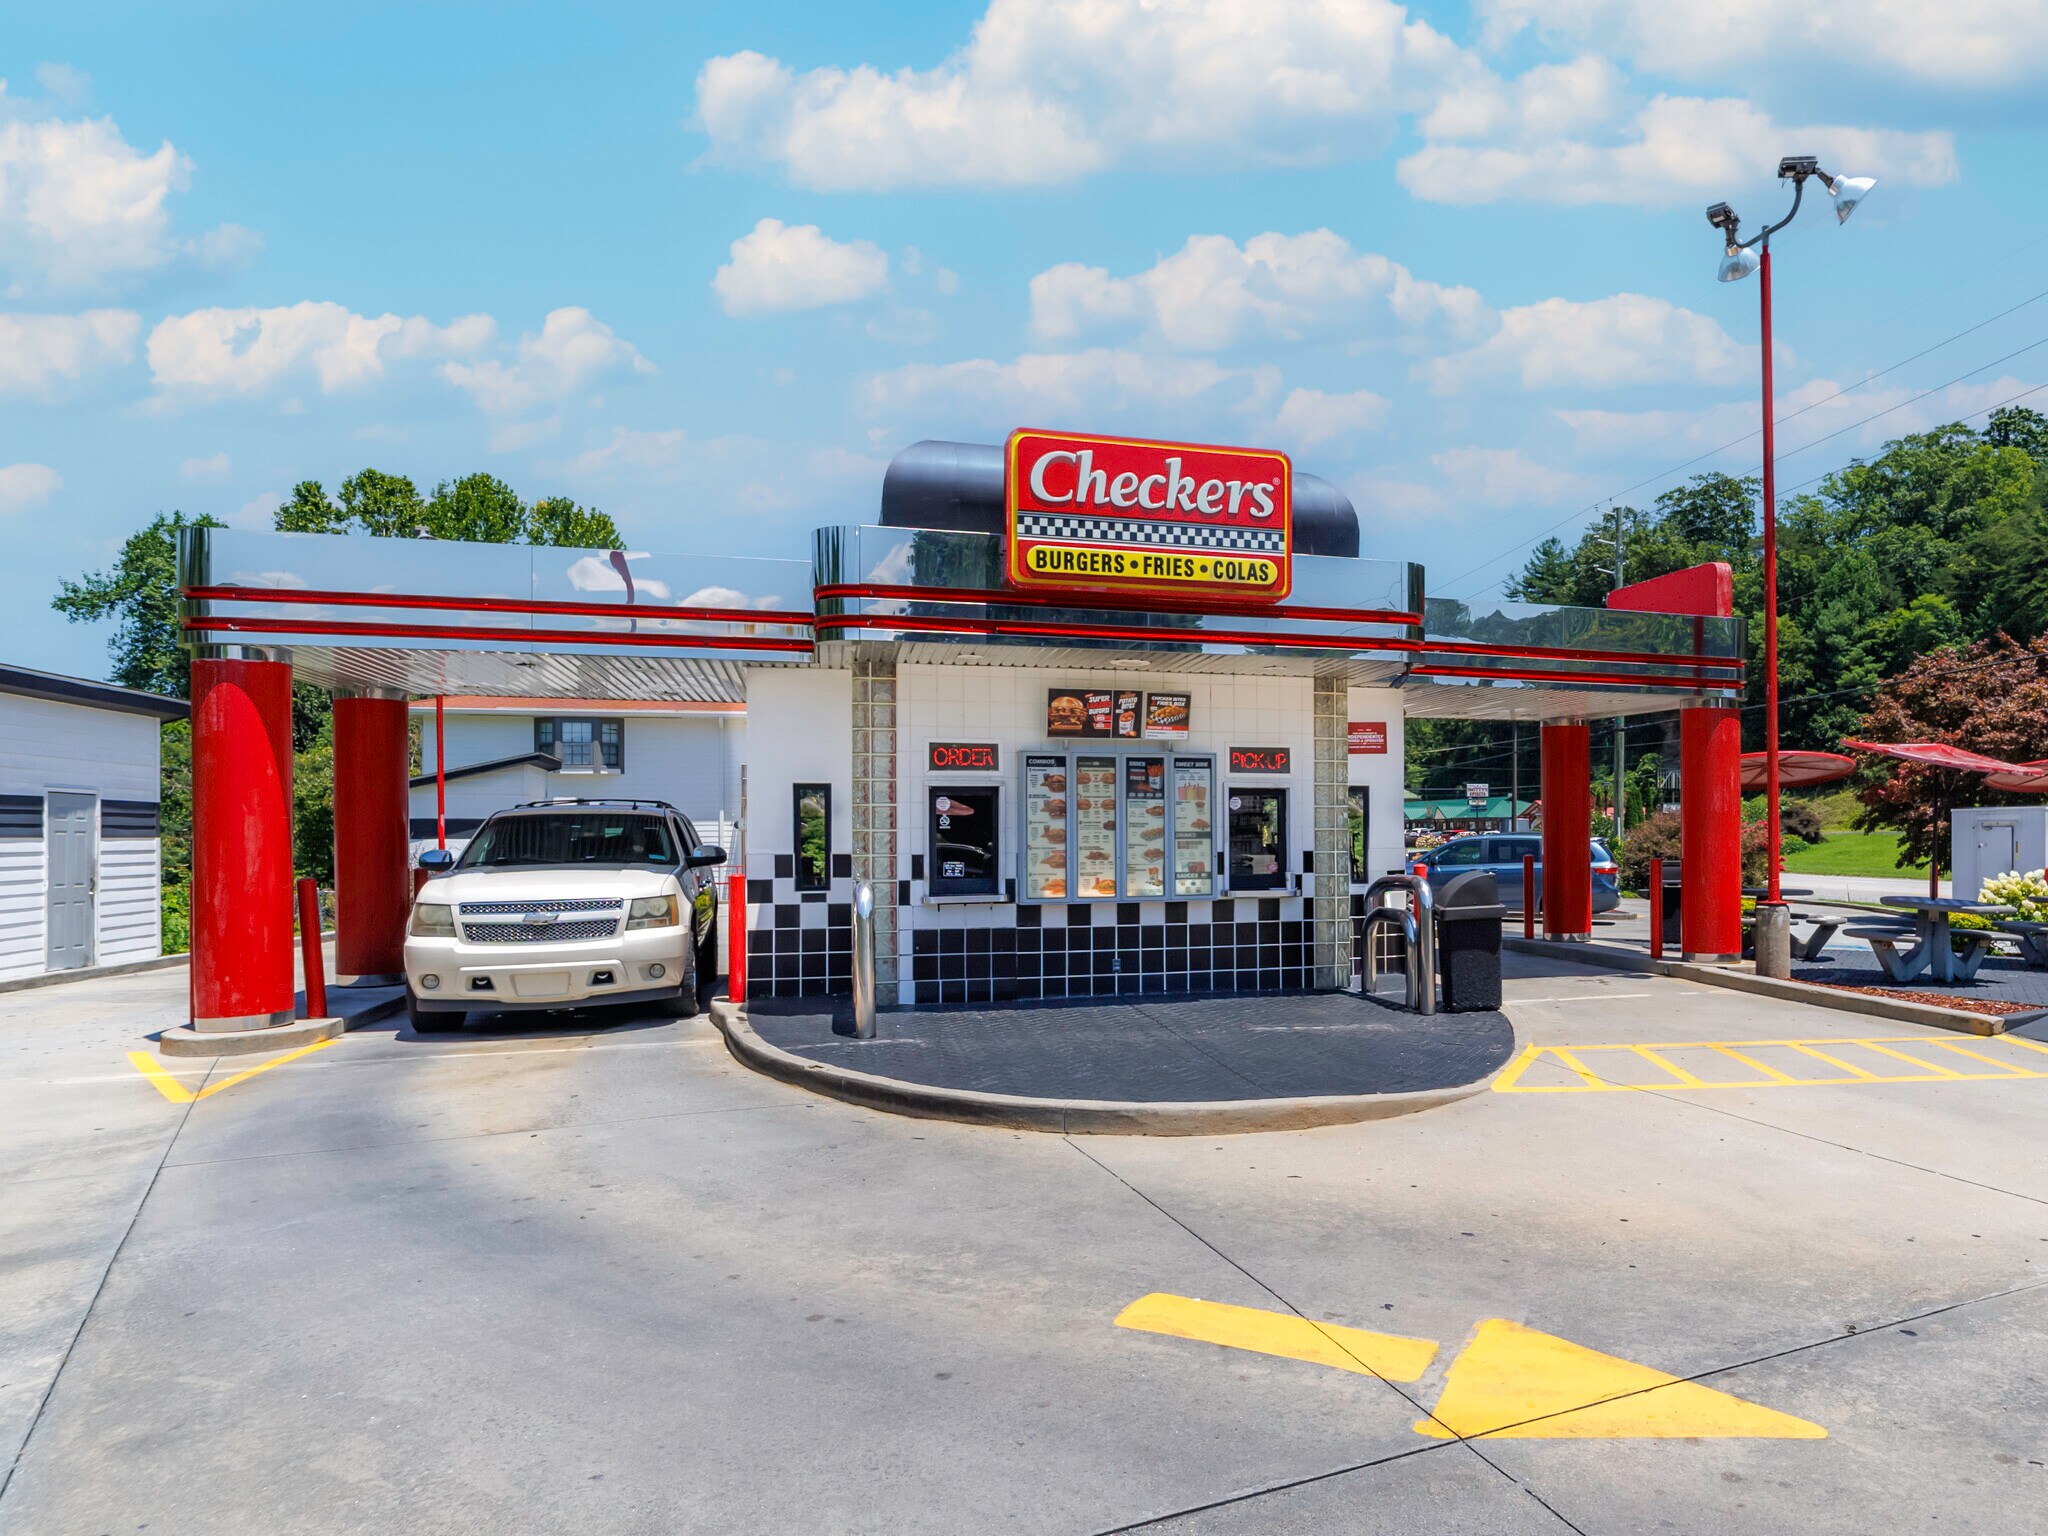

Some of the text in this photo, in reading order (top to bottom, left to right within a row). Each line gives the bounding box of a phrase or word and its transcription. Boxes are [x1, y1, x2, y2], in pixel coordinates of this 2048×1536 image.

[1029, 449, 1275, 518] Checkers
[1035, 549, 1270, 582] BURGERS FRIES COLAS
[1089, 695, 1110, 703] SUPER
[1118, 697, 1138, 705] POTATO
[933, 747, 995, 767] ORDER
